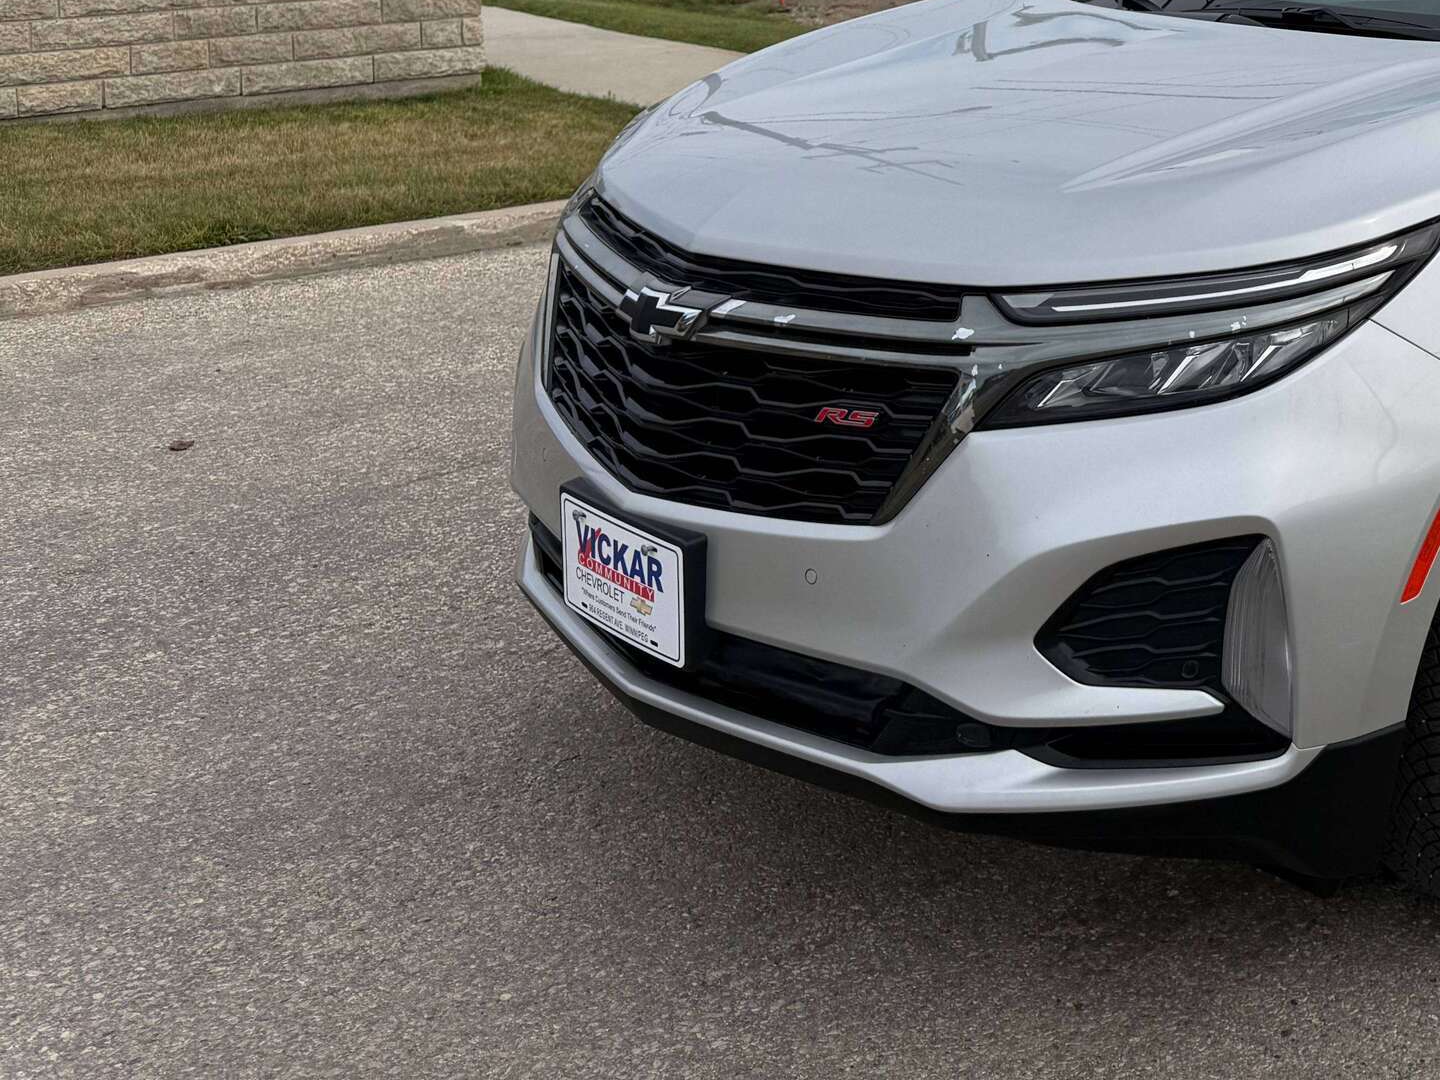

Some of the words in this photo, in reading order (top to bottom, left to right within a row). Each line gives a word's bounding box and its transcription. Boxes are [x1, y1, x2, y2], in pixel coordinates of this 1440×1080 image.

[815, 406, 880, 428] RS
[575, 519, 664, 593] VICKAR
[578, 552, 655, 602] COMMUNITY
[575, 566, 625, 604] CHEVROLET
